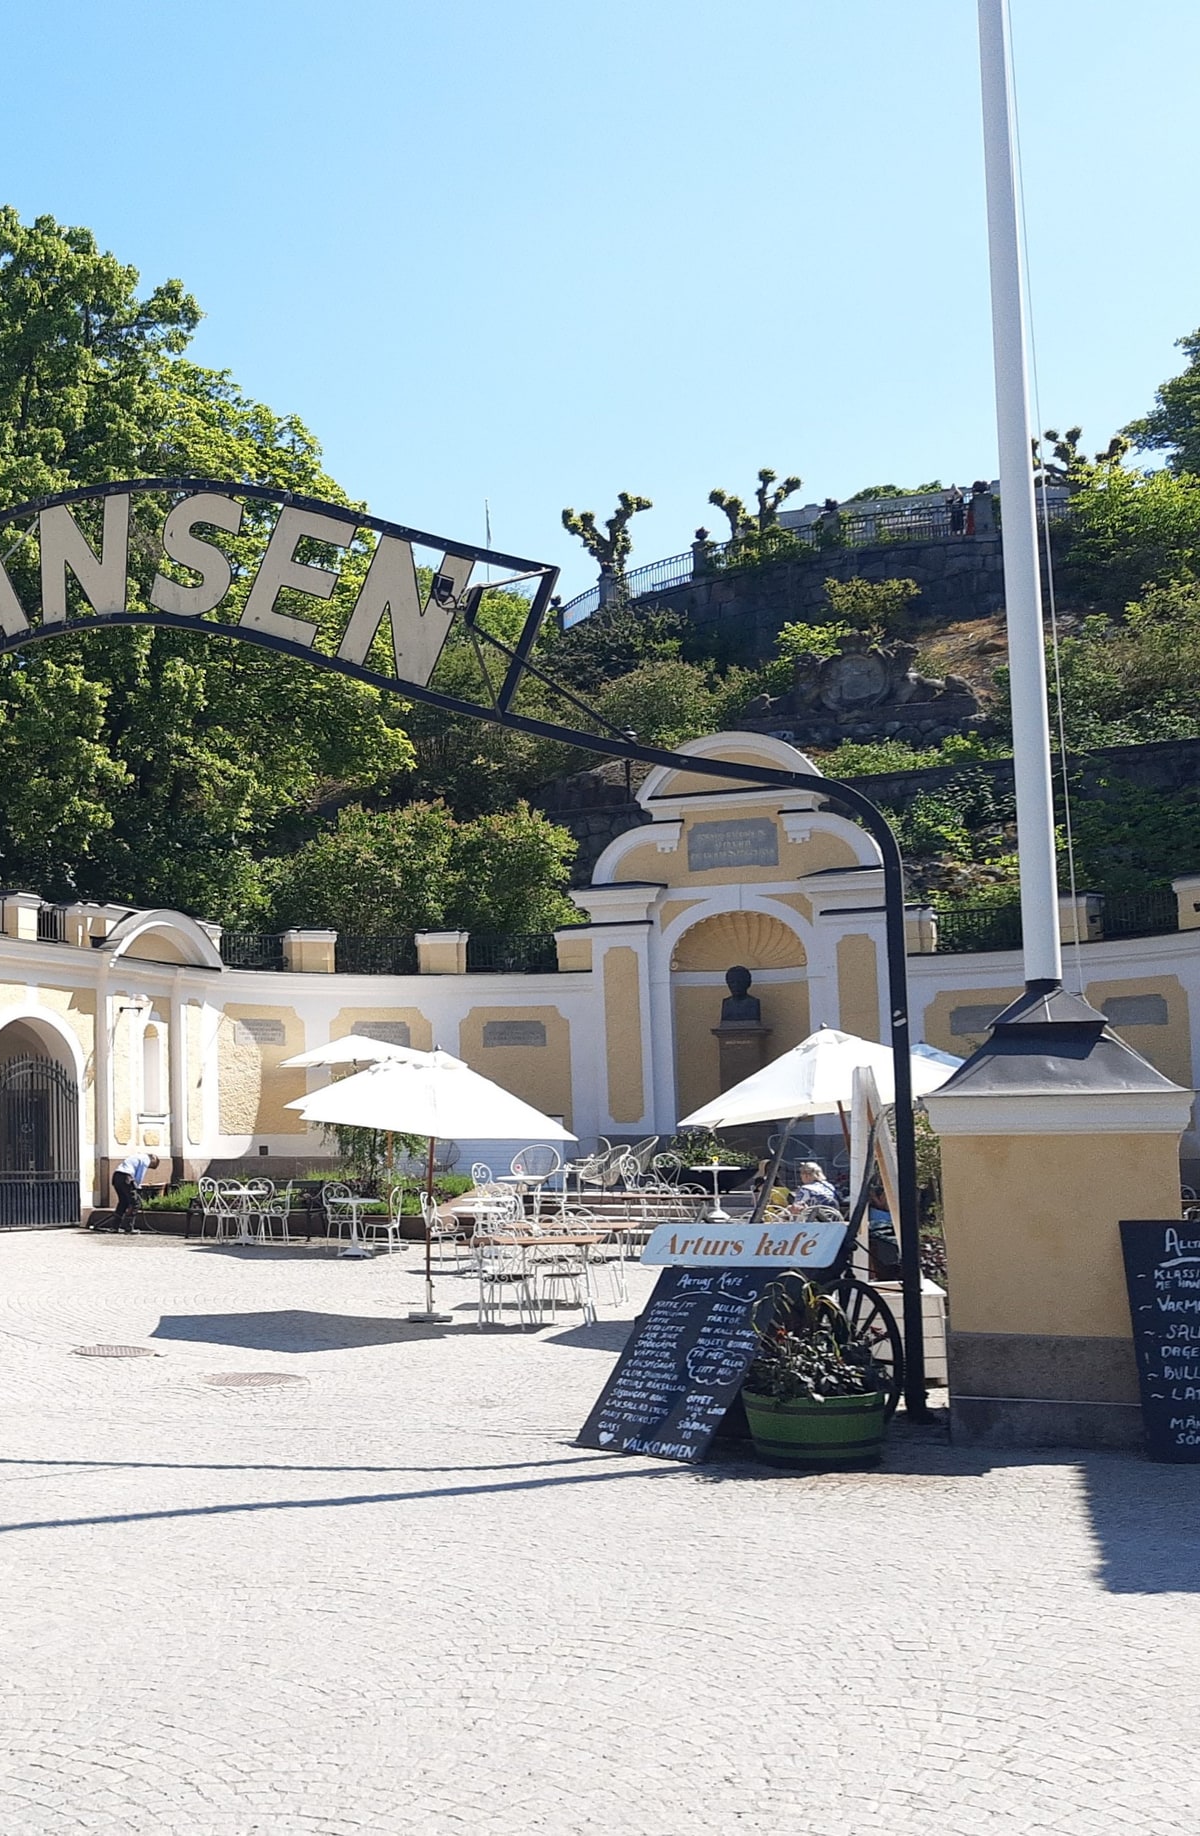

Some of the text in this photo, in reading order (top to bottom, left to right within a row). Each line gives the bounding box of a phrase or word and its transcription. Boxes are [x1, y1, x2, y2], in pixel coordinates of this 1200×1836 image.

[657, 1231, 820, 1257] Arturs kafé
[712, 1303, 747, 1316] BULLAR
[706, 1352, 724, 1360] MED
[598, 1420, 622, 1432] GLASS
[622, 1434, 697, 1458] VÄLKOMMEN
